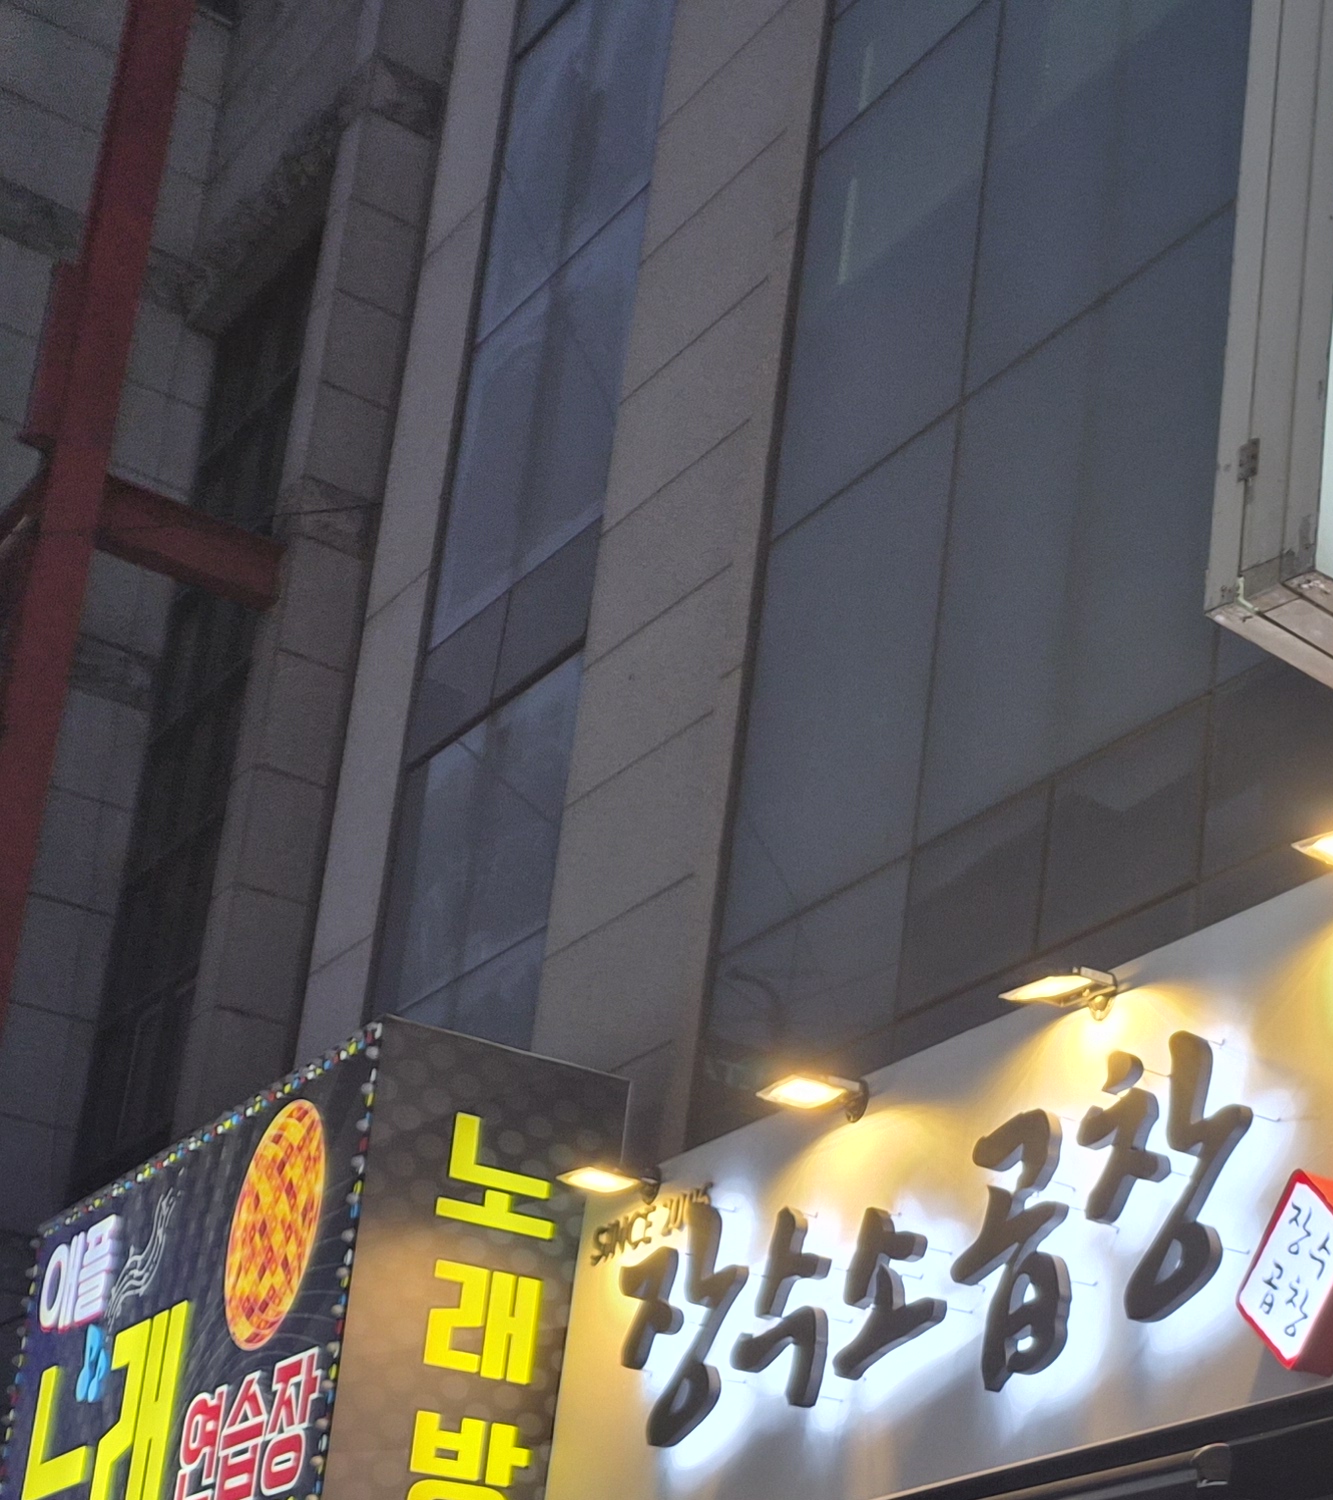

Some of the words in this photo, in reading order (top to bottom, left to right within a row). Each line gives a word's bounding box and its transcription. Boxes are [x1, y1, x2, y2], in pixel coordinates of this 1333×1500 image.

[39, 1214, 122, 1332] 애플
[590, 1205, 656, 1266] SINCE
[620, 1031, 1253, 1448] 장수소곱창
